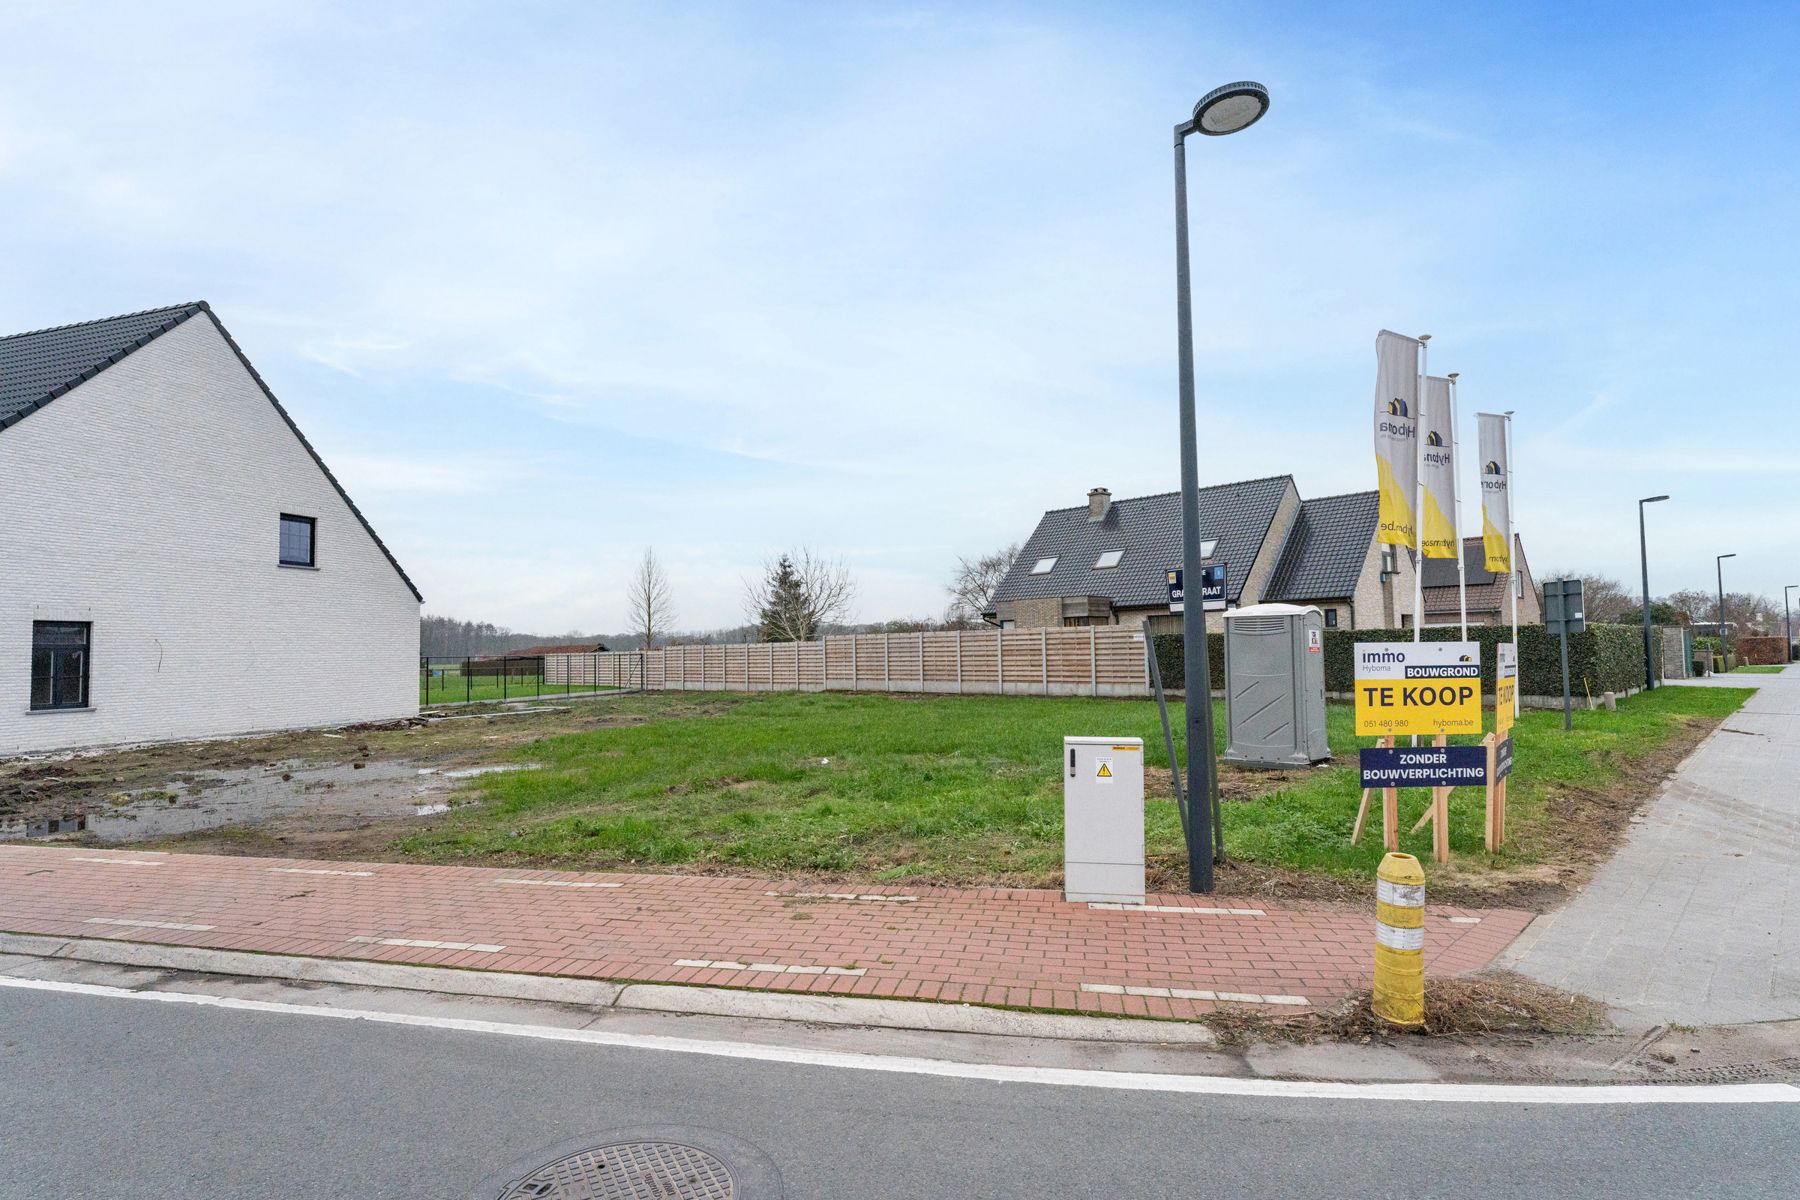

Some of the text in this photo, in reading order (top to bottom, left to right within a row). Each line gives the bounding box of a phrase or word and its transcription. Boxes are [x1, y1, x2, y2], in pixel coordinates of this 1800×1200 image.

[1362, 650, 1406, 663] immo
[1362, 665, 1391, 673] Hyboma
[1407, 667, 1479, 677] BOUWGROND
[1363, 686, 1473, 707] TE KOOP
[1364, 720, 1377, 728] 051
[1433, 719, 1474, 728] hyboma.be
[1400, 754, 1447, 764] ZONDER
[1363, 767, 1484, 780] BOUWVERPLICHTING
